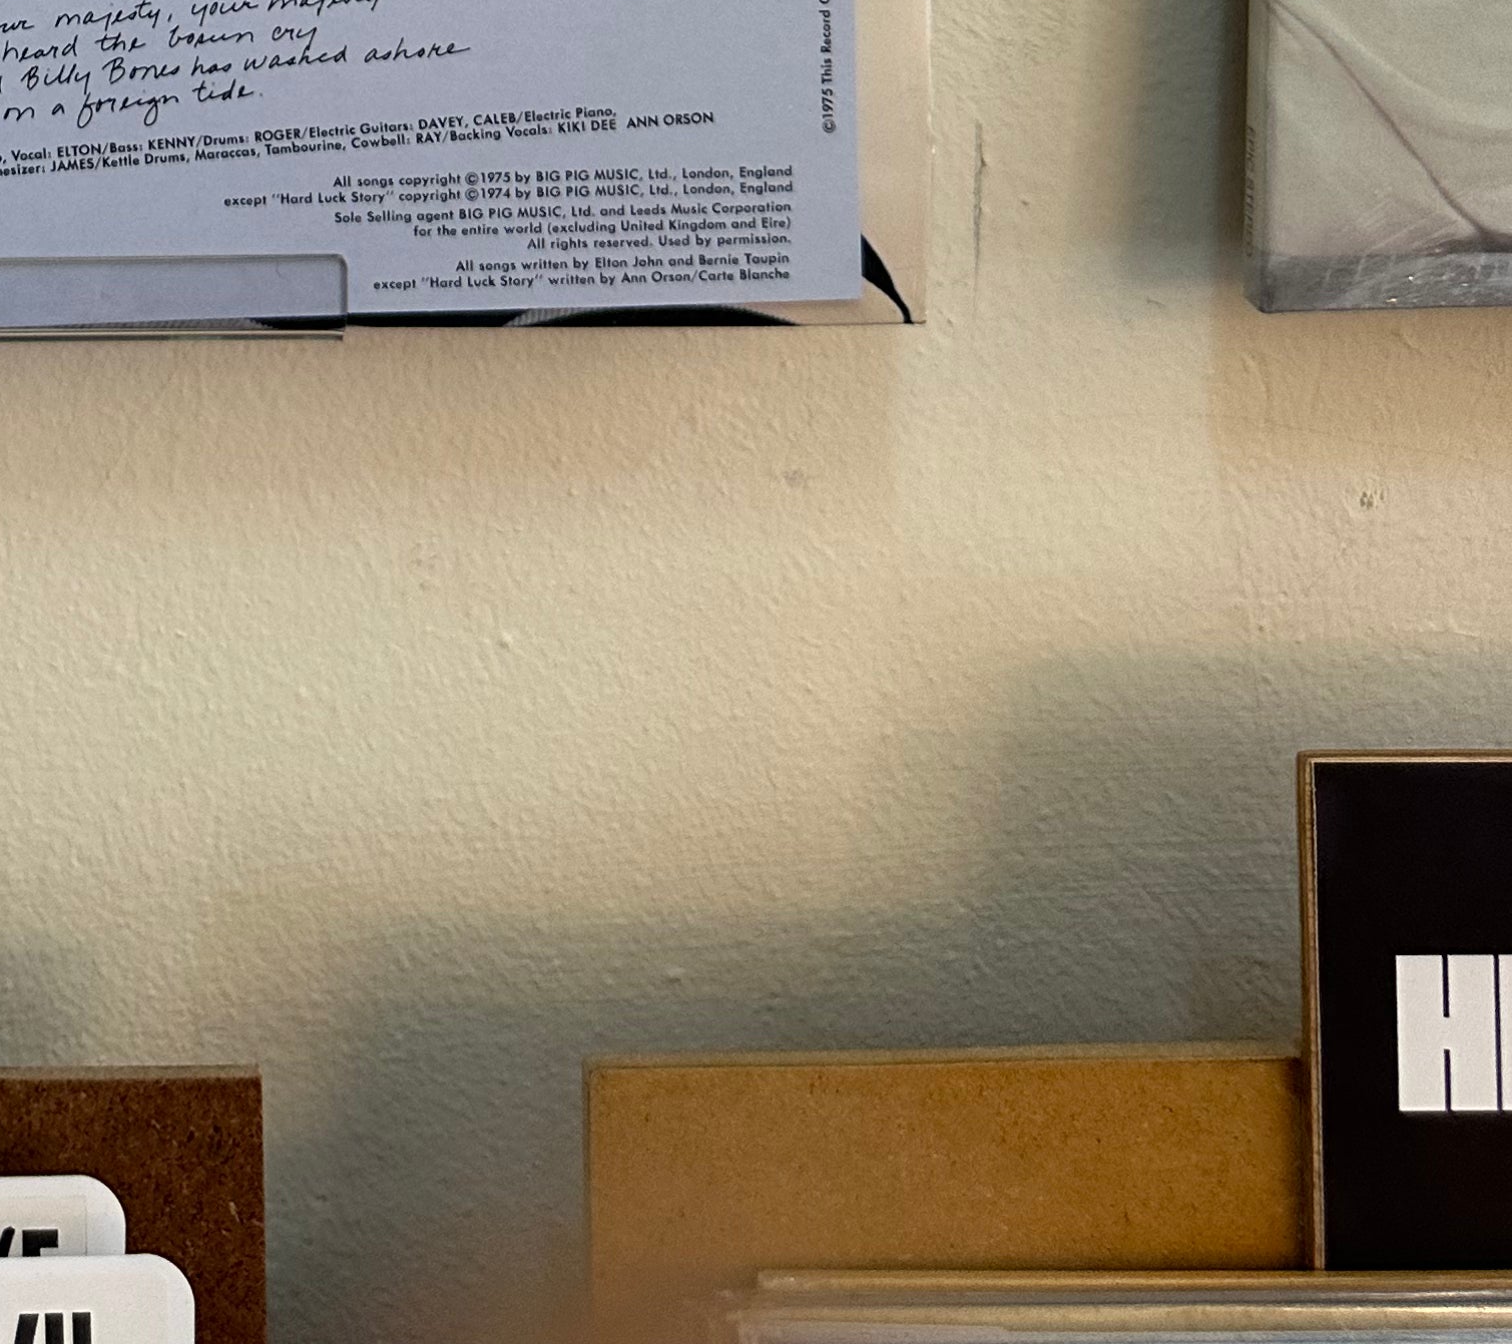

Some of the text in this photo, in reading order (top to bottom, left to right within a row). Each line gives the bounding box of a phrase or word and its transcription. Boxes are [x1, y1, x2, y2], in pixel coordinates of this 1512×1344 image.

[820, 9, 832, 54] Record
[821, 58, 833, 85] This
[527, 233, 791, 252] All rights reserved. Used by permission.
[455, 252, 790, 273] All songs written by Elton John and Bernie Taupin
[1396, 954, 1512, 1113] H
